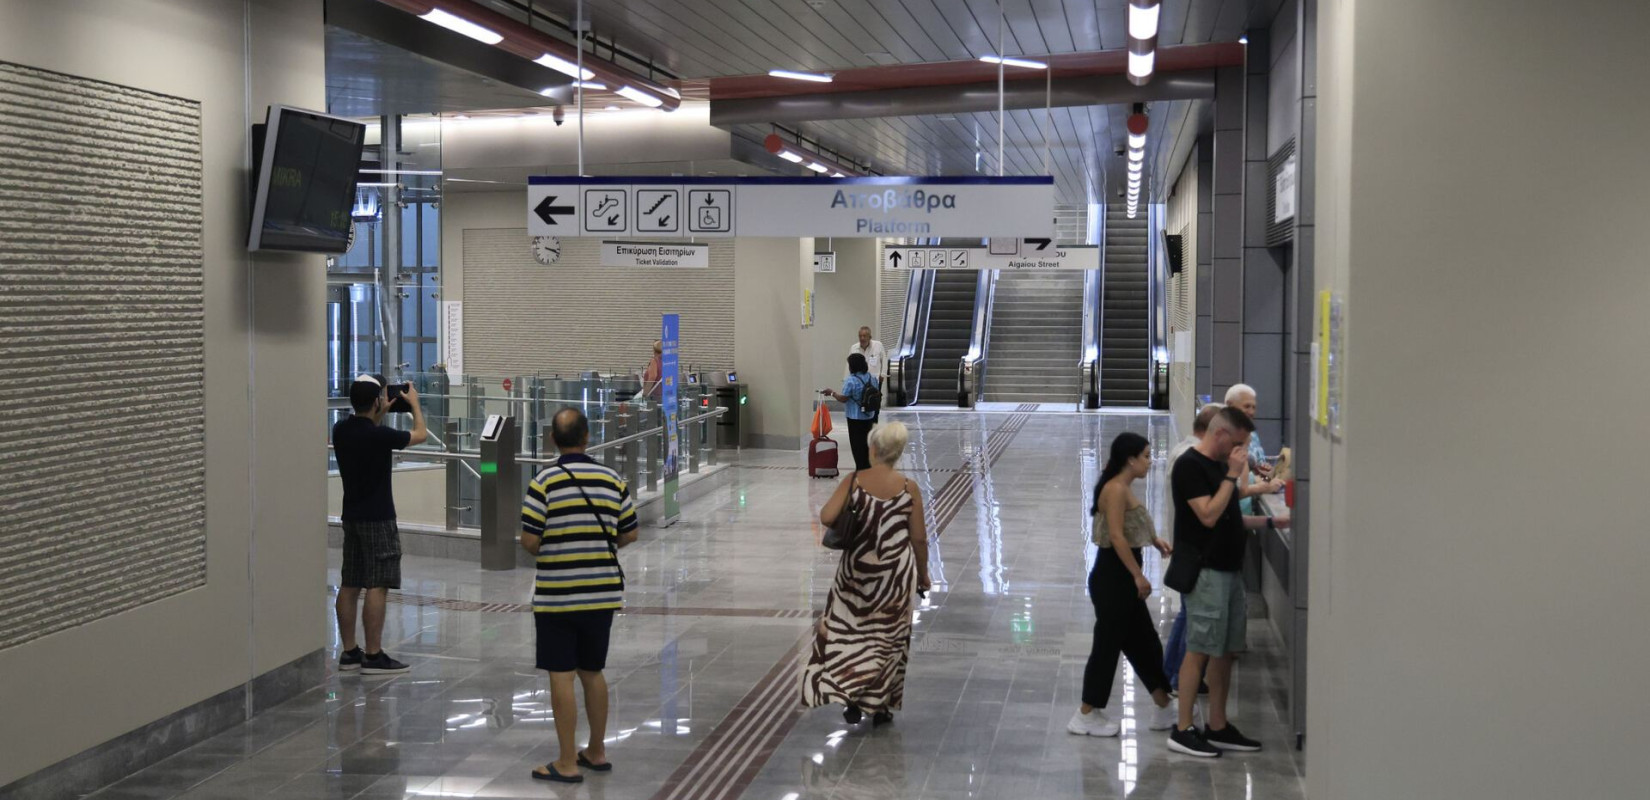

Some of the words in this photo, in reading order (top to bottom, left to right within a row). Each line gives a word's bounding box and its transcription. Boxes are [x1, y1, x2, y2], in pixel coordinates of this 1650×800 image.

[831, 189, 956, 213] Αποβάθρα
[856, 218, 931, 233] Platform
[616, 246, 657, 257] Επικύρωση
[658, 247, 695, 258] Εισιτηρίων
[1008, 261, 1036, 269] Aigaiou
